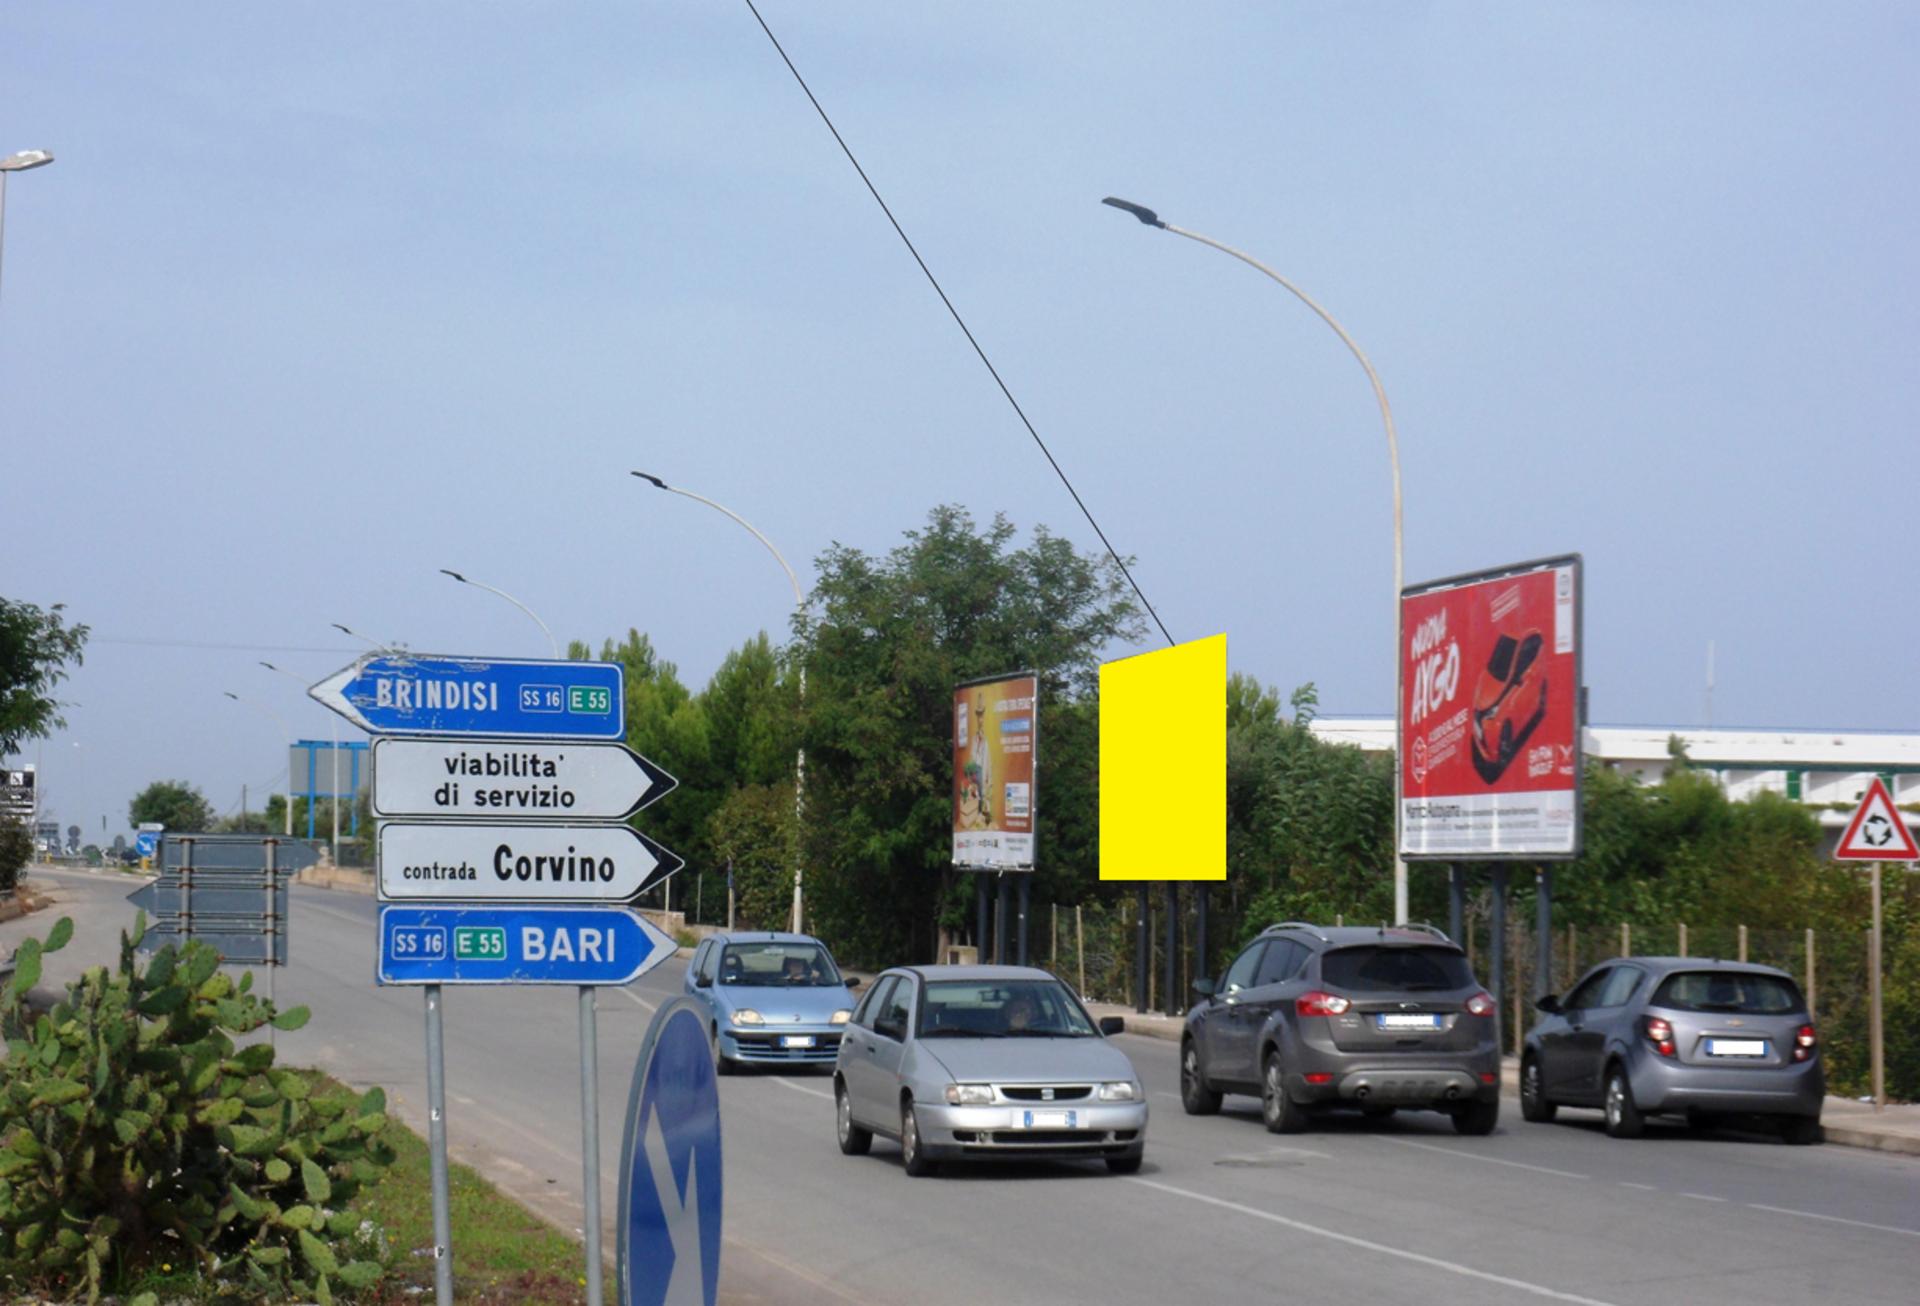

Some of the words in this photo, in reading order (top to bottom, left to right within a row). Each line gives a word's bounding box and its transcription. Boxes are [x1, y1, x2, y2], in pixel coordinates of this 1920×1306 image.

[376, 679, 498, 710] BRINDISI
[523, 689, 541, 706] SS
[545, 690, 560, 707] 16
[572, 690, 583, 708] E
[588, 691, 607, 709] 55
[1411, 642, 1460, 725] AYGO
[444, 753, 565, 778] viabilita'
[434, 782, 459, 806] di
[474, 785, 575, 808] servizio
[403, 862, 477, 881] contrada
[493, 844, 615, 882] Corvino
[396, 935, 417, 953] SS
[424, 935, 442, 953] 16
[458, 935, 472, 953] E
[478, 934, 502, 953] 55
[521, 927, 615, 962] BARI
